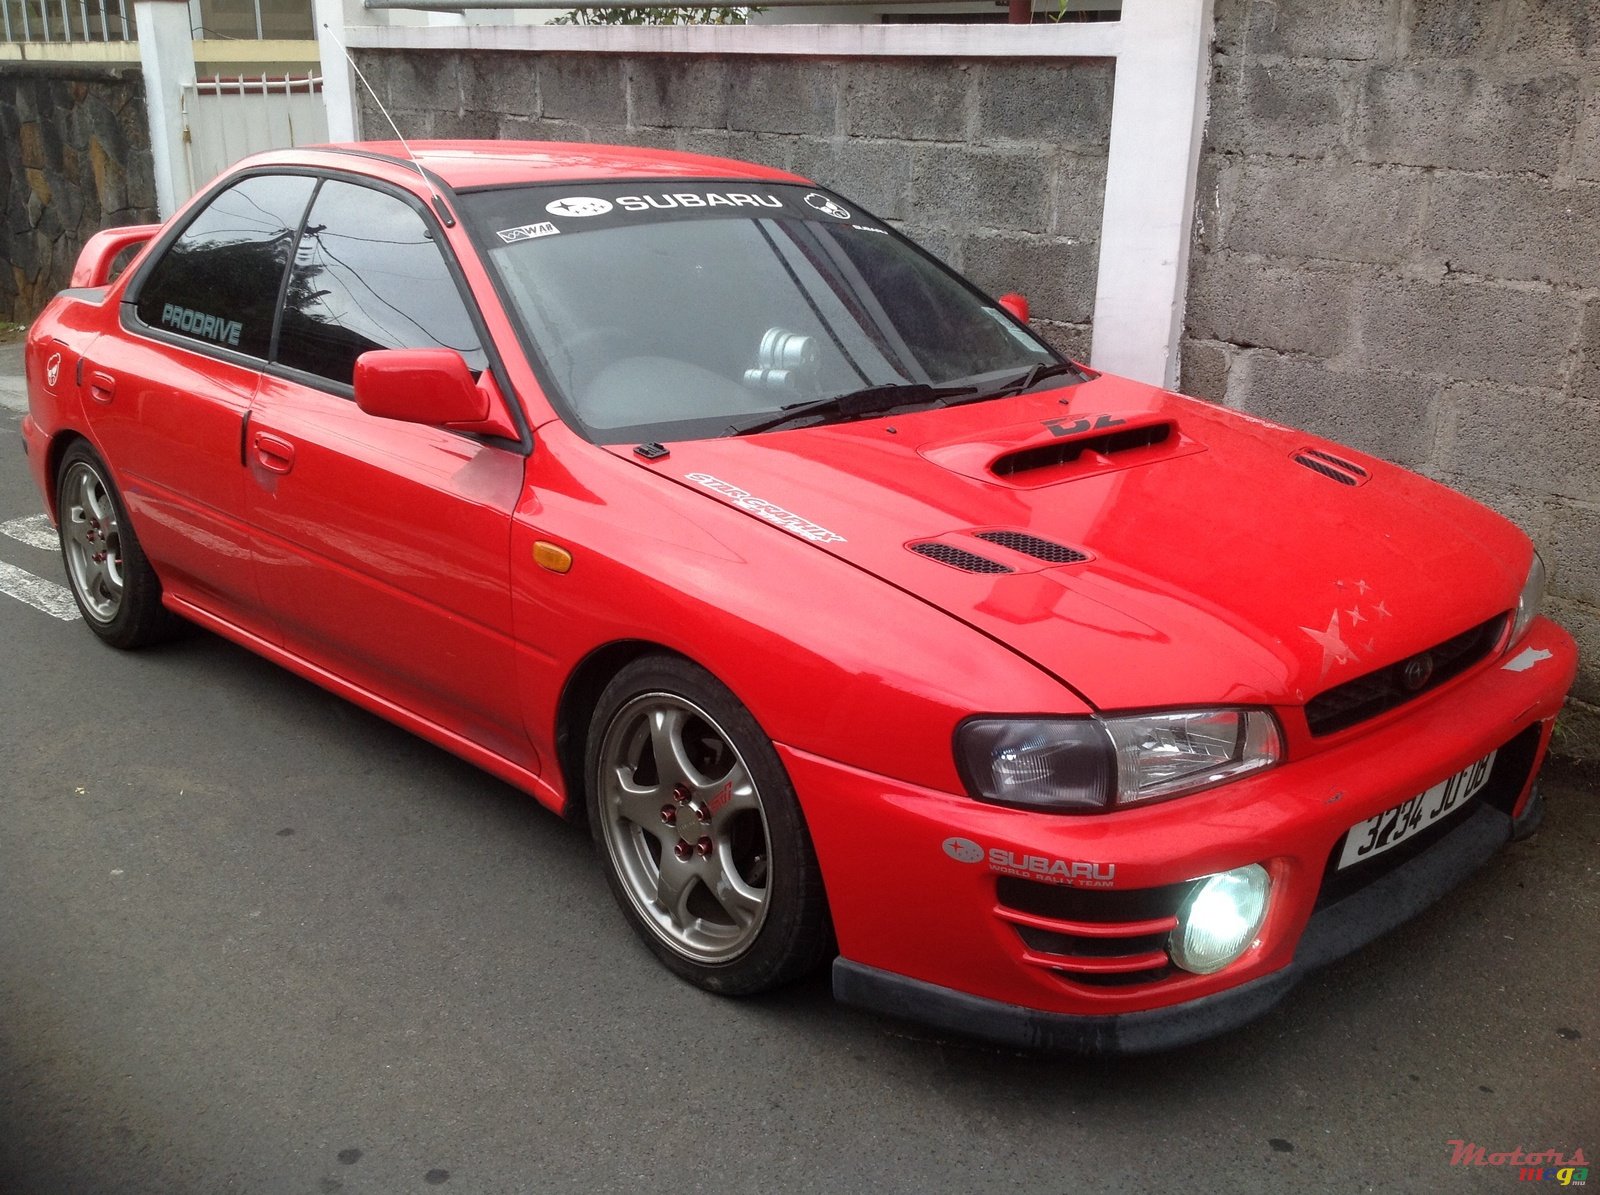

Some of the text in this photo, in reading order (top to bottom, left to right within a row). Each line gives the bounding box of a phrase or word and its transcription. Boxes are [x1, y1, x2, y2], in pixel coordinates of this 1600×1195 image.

[615, 193, 783, 211] SUBARU
[162, 303, 243, 346] PRODRIVE
[684, 472, 750, 499] STAR
[988, 863, 1031, 878] WORLD
[1036, 873, 1074, 885] RALLY
[989, 848, 1115, 880] SUBARU
